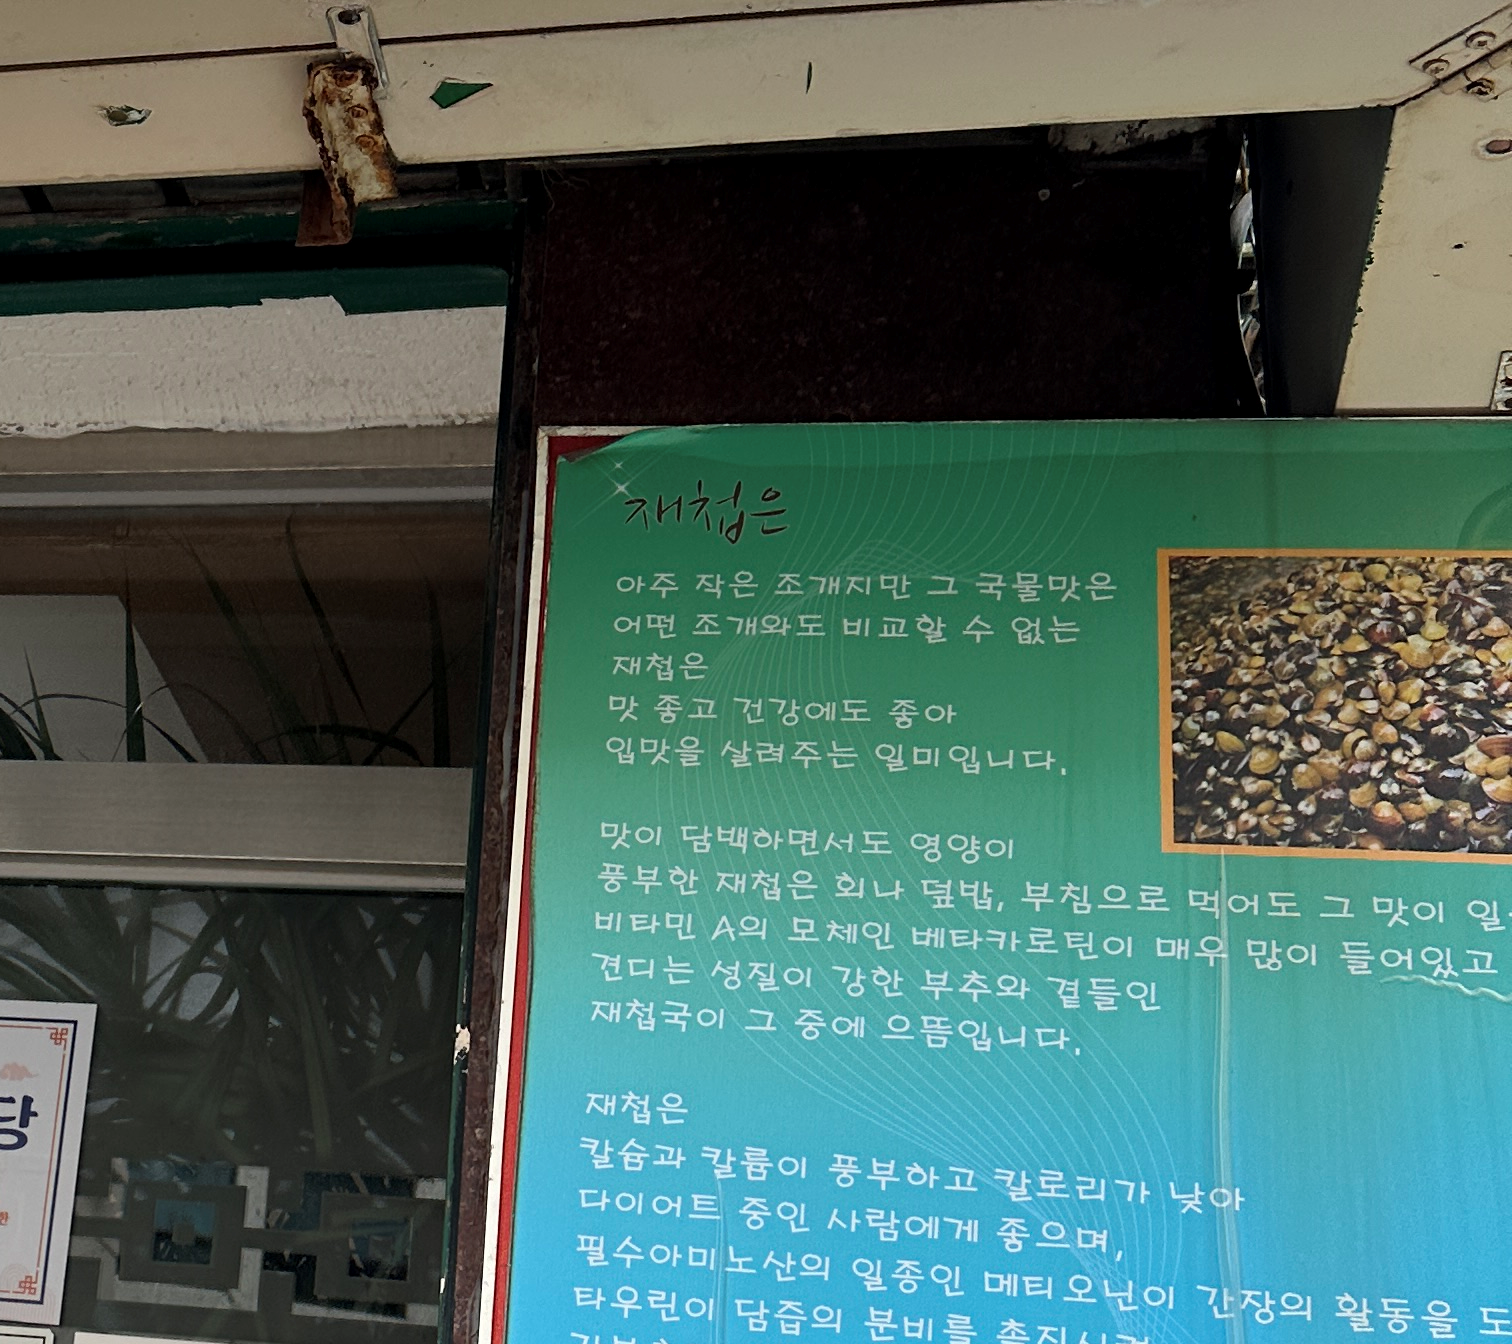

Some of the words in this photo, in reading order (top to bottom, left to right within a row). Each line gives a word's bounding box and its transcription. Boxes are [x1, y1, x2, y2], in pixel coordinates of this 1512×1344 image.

[625, 480, 789, 544] 재첩은
[616, 572, 679, 595] 아주
[695, 570, 759, 600] 작은
[776, 573, 912, 600] 조개지만
[926, 576, 959, 596] 그
[975, 571, 1118, 603] 국물맛은
[613, 614, 677, 639] 어떤
[693, 615, 826, 639] 조개와도
[843, 614, 947, 644] 비교할
[962, 616, 995, 644] 수
[1010, 616, 1081, 645] 없는
[611, 653, 709, 681] 재첩은
[609, 695, 639, 722] 맛
[654, 695, 718, 725] 좋고
[733, 697, 871, 726] 건강에도
[889, 699, 958, 729] 좋아
[606, 736, 704, 767] 입맛을
[721, 739, 858, 770] 살려주는
[875, 742, 1067, 776] 일미입니다.
[600, 821, 662, 849] 맛이
[681, 824, 893, 856] 담백하면서도
[910, 832, 1014, 863] 영양이
[597, 862, 698, 896] 풍부한
[716, 870, 818, 901] 재첩은
[835, 872, 905, 900] 회나
[920, 878, 1004, 911] 덮밥,
[1021, 881, 1171, 915] 부침으로
[1188, 889, 1302, 920] 먹어도
[1320, 896, 1354, 918] 그
[1373, 896, 1444, 928] 맛이
[595, 911, 696, 941] 비타민
[711, 915, 767, 941] A의
[788, 917, 895, 950] 모체인
[911, 922, 1134, 961] 베타카로틴이
[1156, 936, 1228, 966] 매우
[1247, 939, 1317, 971] 많이
[1340, 941, 1499, 978] 들어있고
[591, 953, 695, 983] 견디는
[710, 958, 813, 992] 성질이
[831, 965, 904, 998] 강한
[920, 968, 1031, 1003] 부추와
[1048, 976, 1162, 1011] 곁들인
[590, 998, 725, 1033] 재첩국이
[745, 1008, 776, 1032] 그
[794, 1007, 866, 1040] 중에
[881, 1014, 1082, 1056] 으뜸입니다.
[586, 1092, 689, 1125] 재첩은
[579, 1136, 686, 1171] 칼슘과
[700, 1146, 807, 1181] 칼륨이
[828, 1153, 978, 1192] 풍부하고
[993, 1167, 1151, 1204] 칼로리가
[1170, 1181, 1246, 1213] 낮아
[578, 1188, 721, 1220] 다이어트
[739, 1196, 810, 1233] 중인
[826, 1206, 979, 1242] 사람에게
[996, 1216, 1124, 1262] 좋으며,
[574, 1285, 714, 1323] 타우린이
[735, 1298, 842, 1335] 담즙의
[577, 1233, 830, 1282] 필수아미노산의
[852, 1257, 965, 1297] 일종인
[983, 1271, 1175, 1312] 메티오닌이
[1196, 1286, 1313, 1325] 간장의
[1335, 1293, 1458, 1339] 활동을
